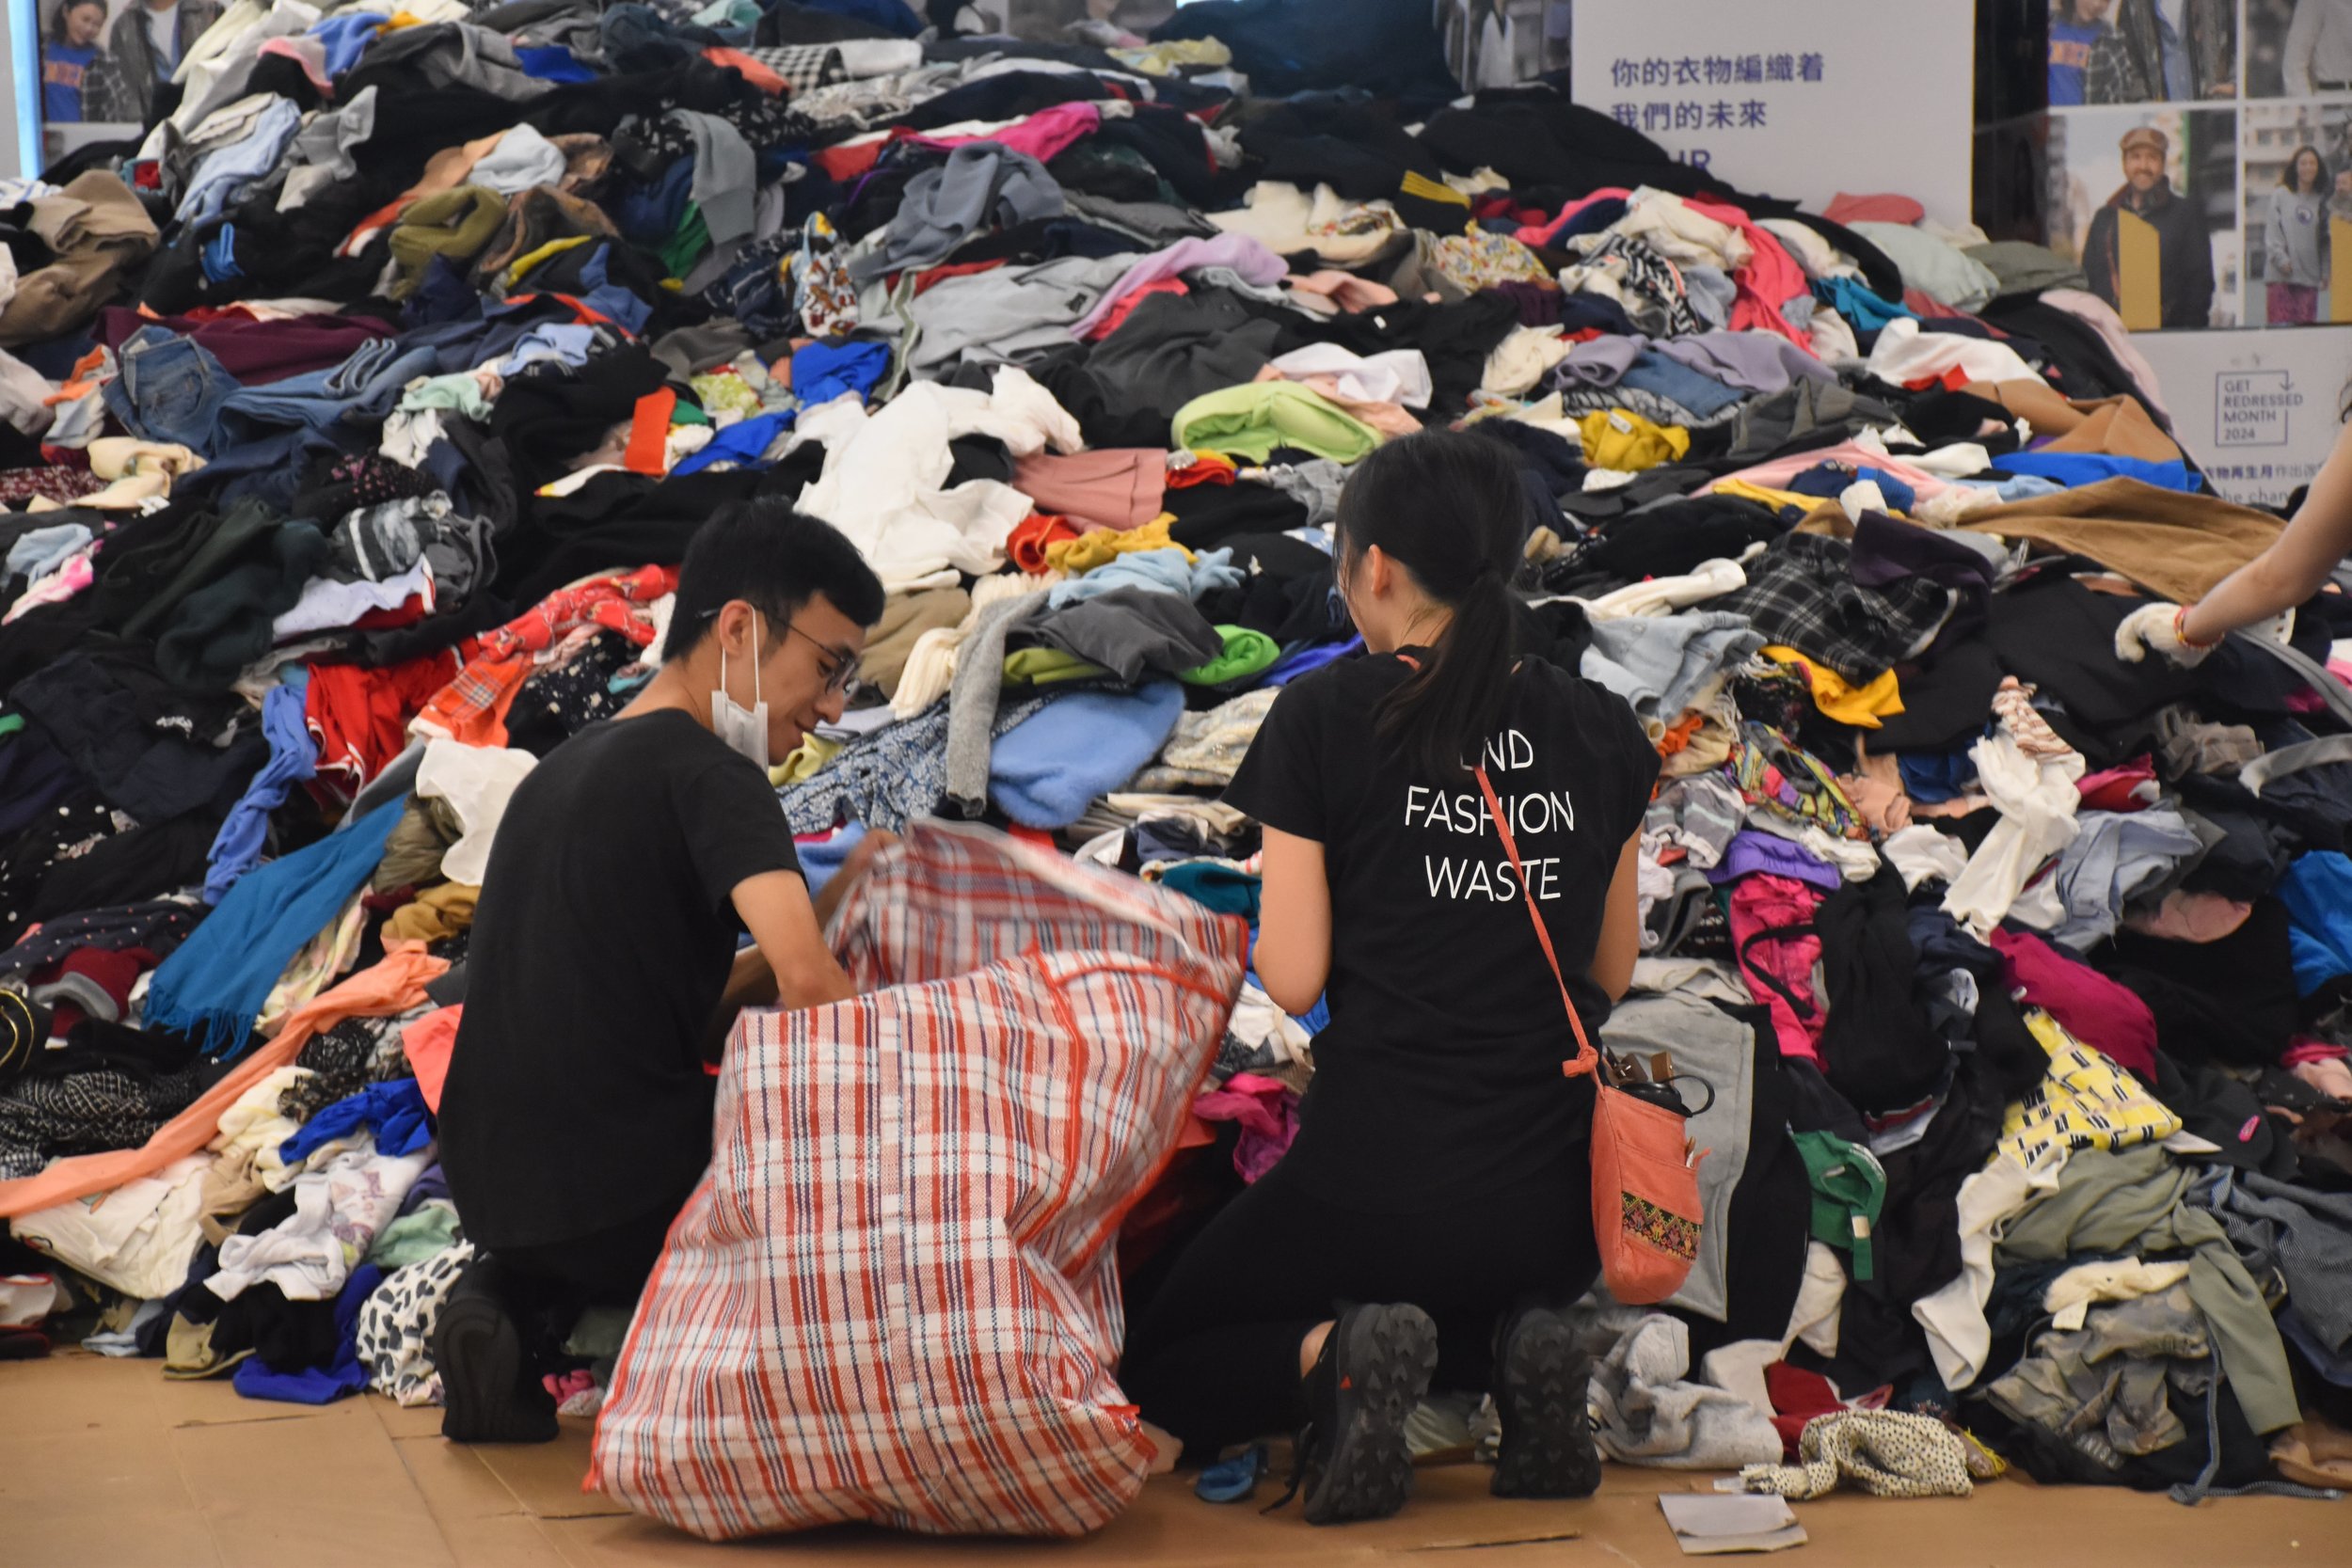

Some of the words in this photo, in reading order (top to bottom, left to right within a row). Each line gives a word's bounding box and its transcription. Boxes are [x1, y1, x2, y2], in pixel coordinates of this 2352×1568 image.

[1611, 53, 1824, 87] 你的衣物編織着
[1611, 99, 1767, 132] 我們的未來
[2224, 379, 2250, 393] GET
[2224, 393, 2303, 407] REDRESSED
[2224, 410, 2276, 423] MONTH
[2224, 428, 2255, 440] 2024
[2249, 485, 2288, 503] chan
[1405, 785, 1574, 837] FASHION
[1425, 855, 1561, 902] WASTE
